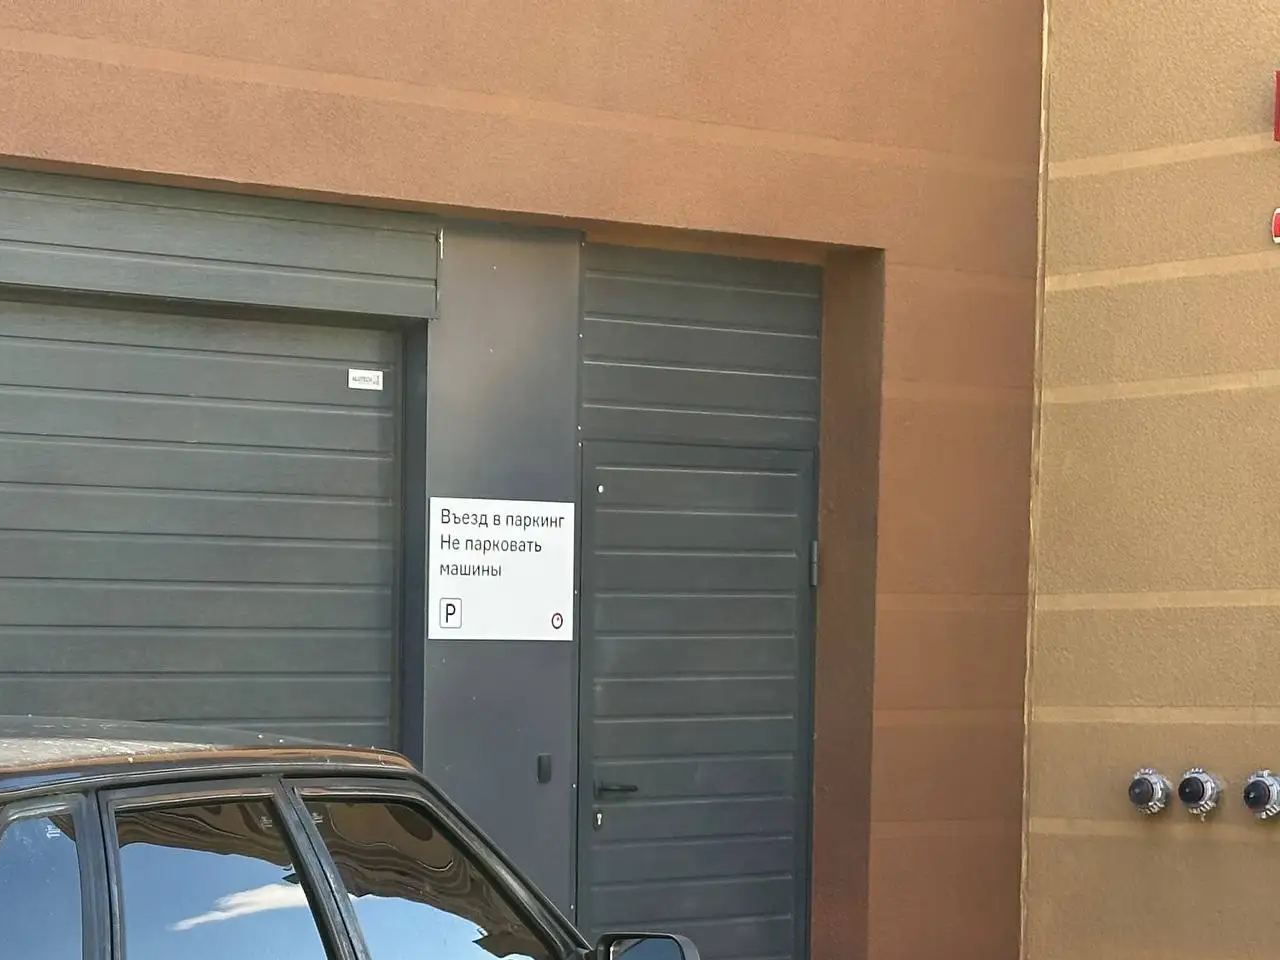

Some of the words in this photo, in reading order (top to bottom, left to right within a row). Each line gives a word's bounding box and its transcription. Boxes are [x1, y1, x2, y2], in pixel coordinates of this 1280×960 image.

[440, 508, 489, 527] Въезд
[493, 514, 501, 526] в
[505, 514, 565, 531] паркинг
[440, 533, 460, 551] Не
[465, 537, 542, 555] парковать
[439, 563, 502, 577] машины
